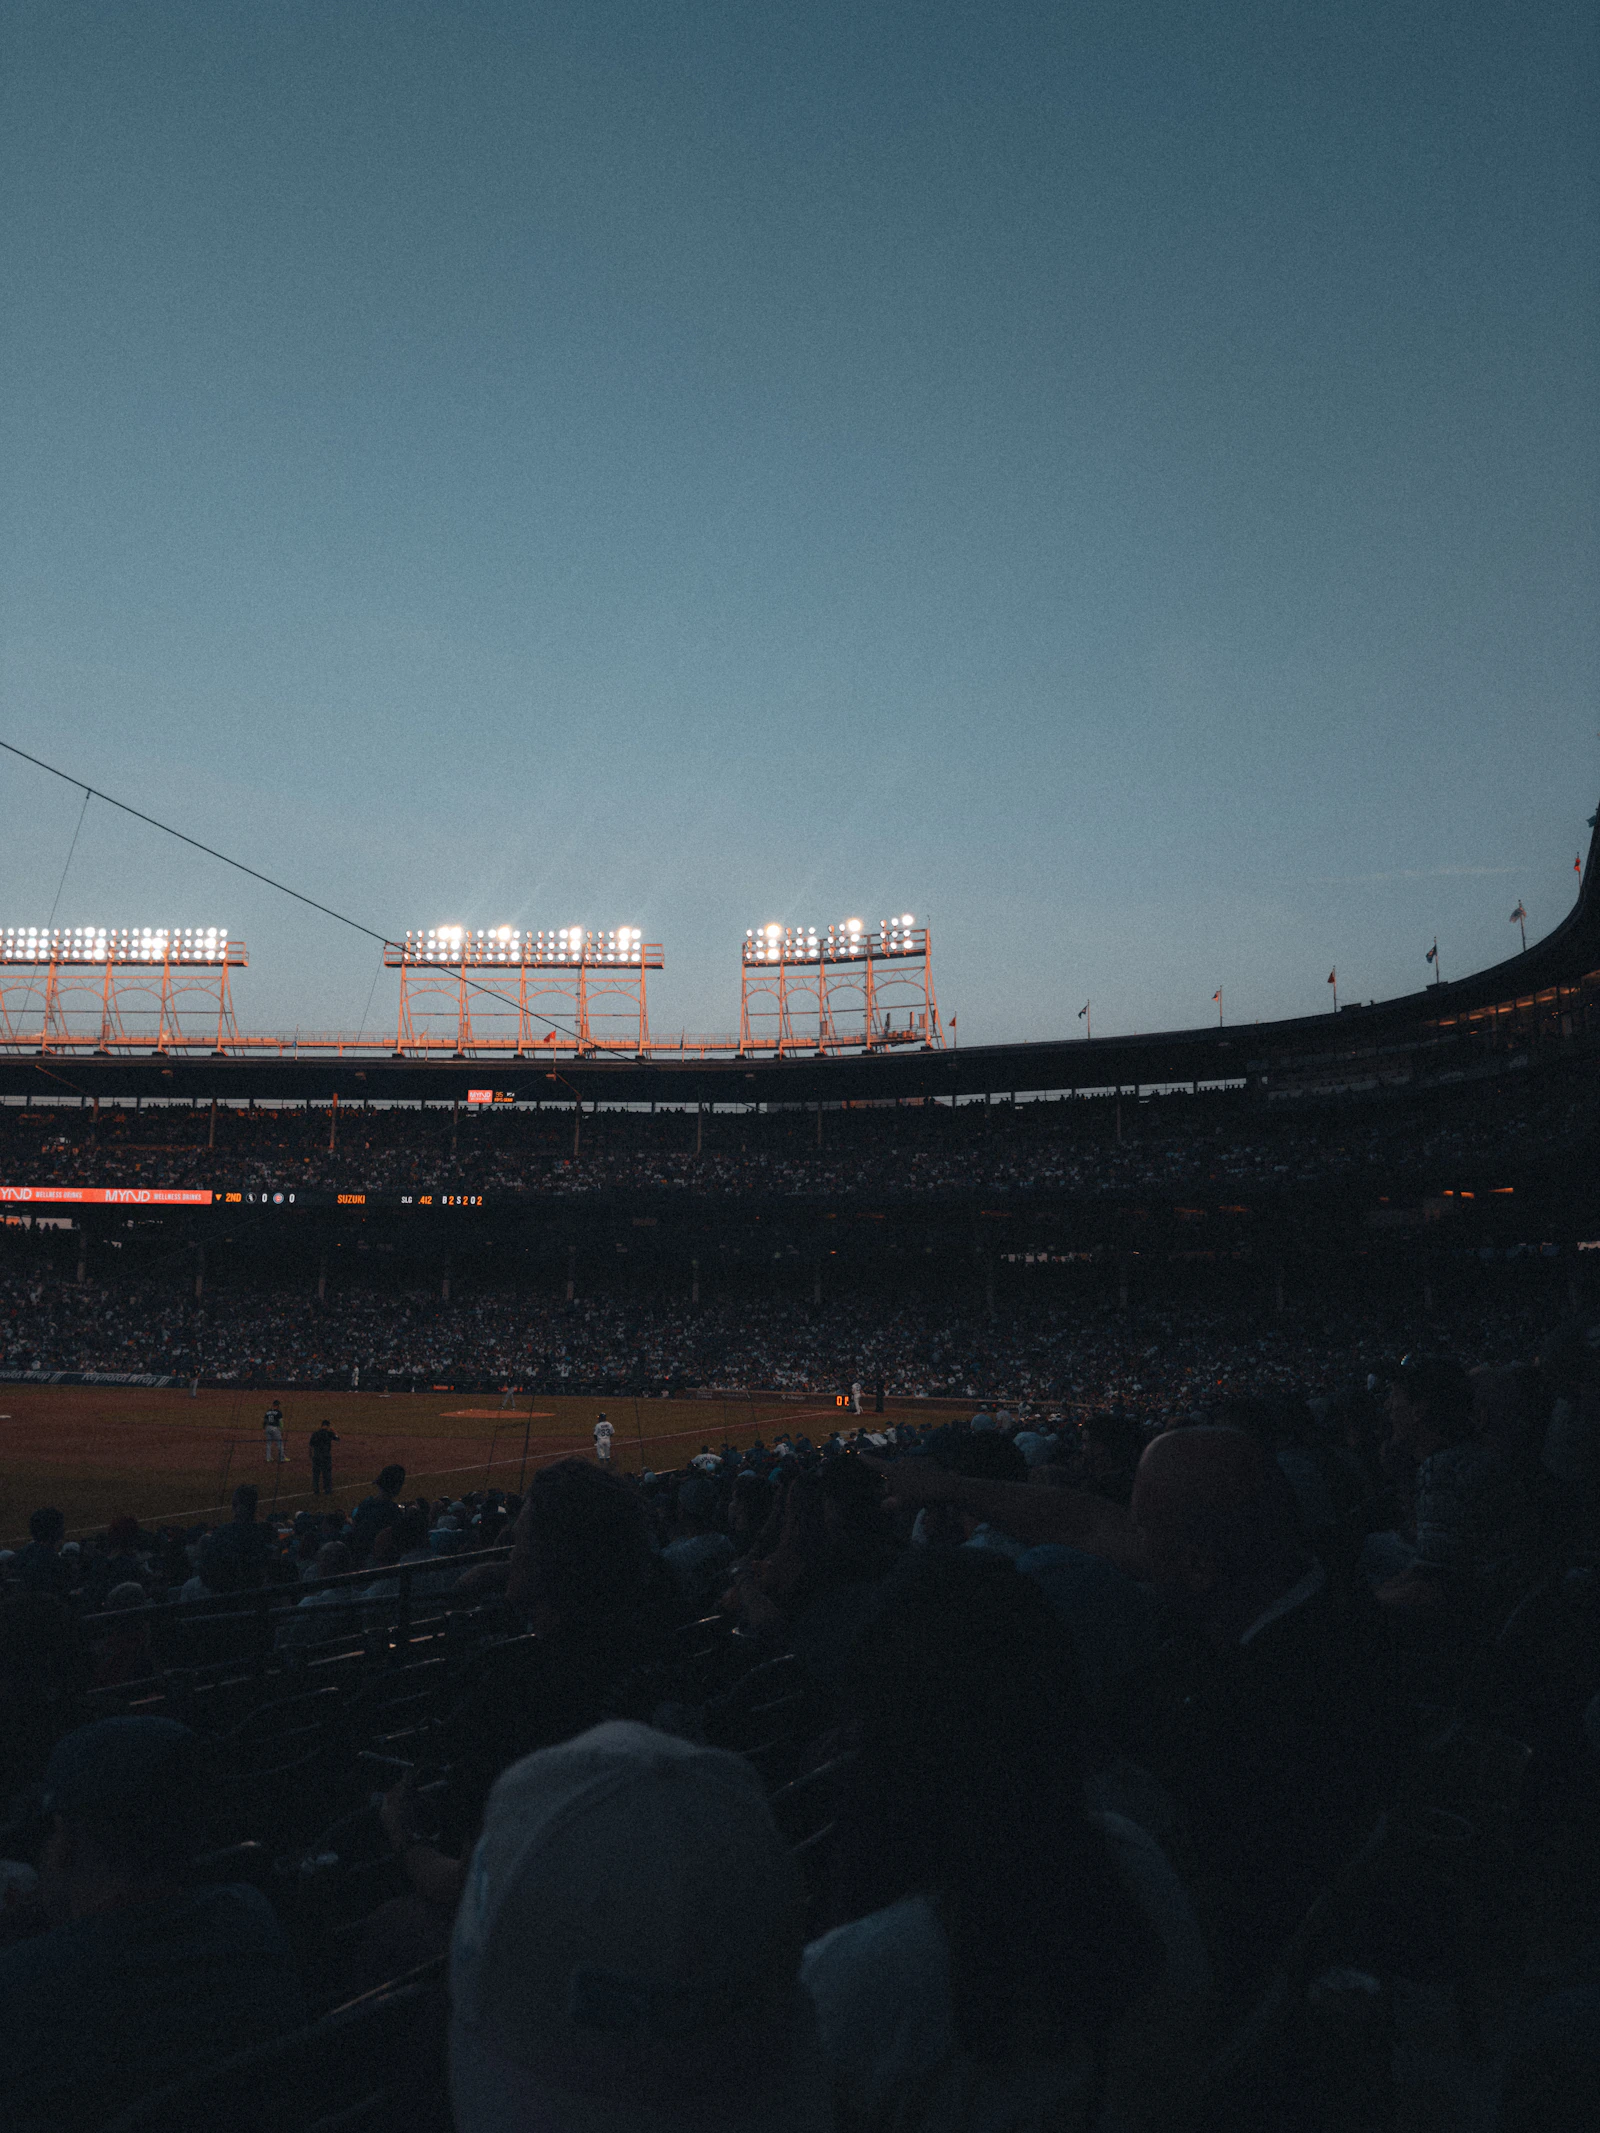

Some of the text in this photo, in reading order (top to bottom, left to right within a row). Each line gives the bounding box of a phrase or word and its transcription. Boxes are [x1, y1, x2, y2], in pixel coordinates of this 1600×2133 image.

[0, 1187, 32, 1200] YND
[63, 1191, 82, 1199] DRINKS
[105, 1189, 150, 1202] MYND
[182, 1193, 202, 1201] DRINKS
[225, 1192, 242, 1203] 2ND
[261, 1193, 268, 1203] 0
[289, 1193, 296, 1204] 0
[337, 1194, 366, 1205] SUZUKI
[401, 1195, 413, 1204] SLG
